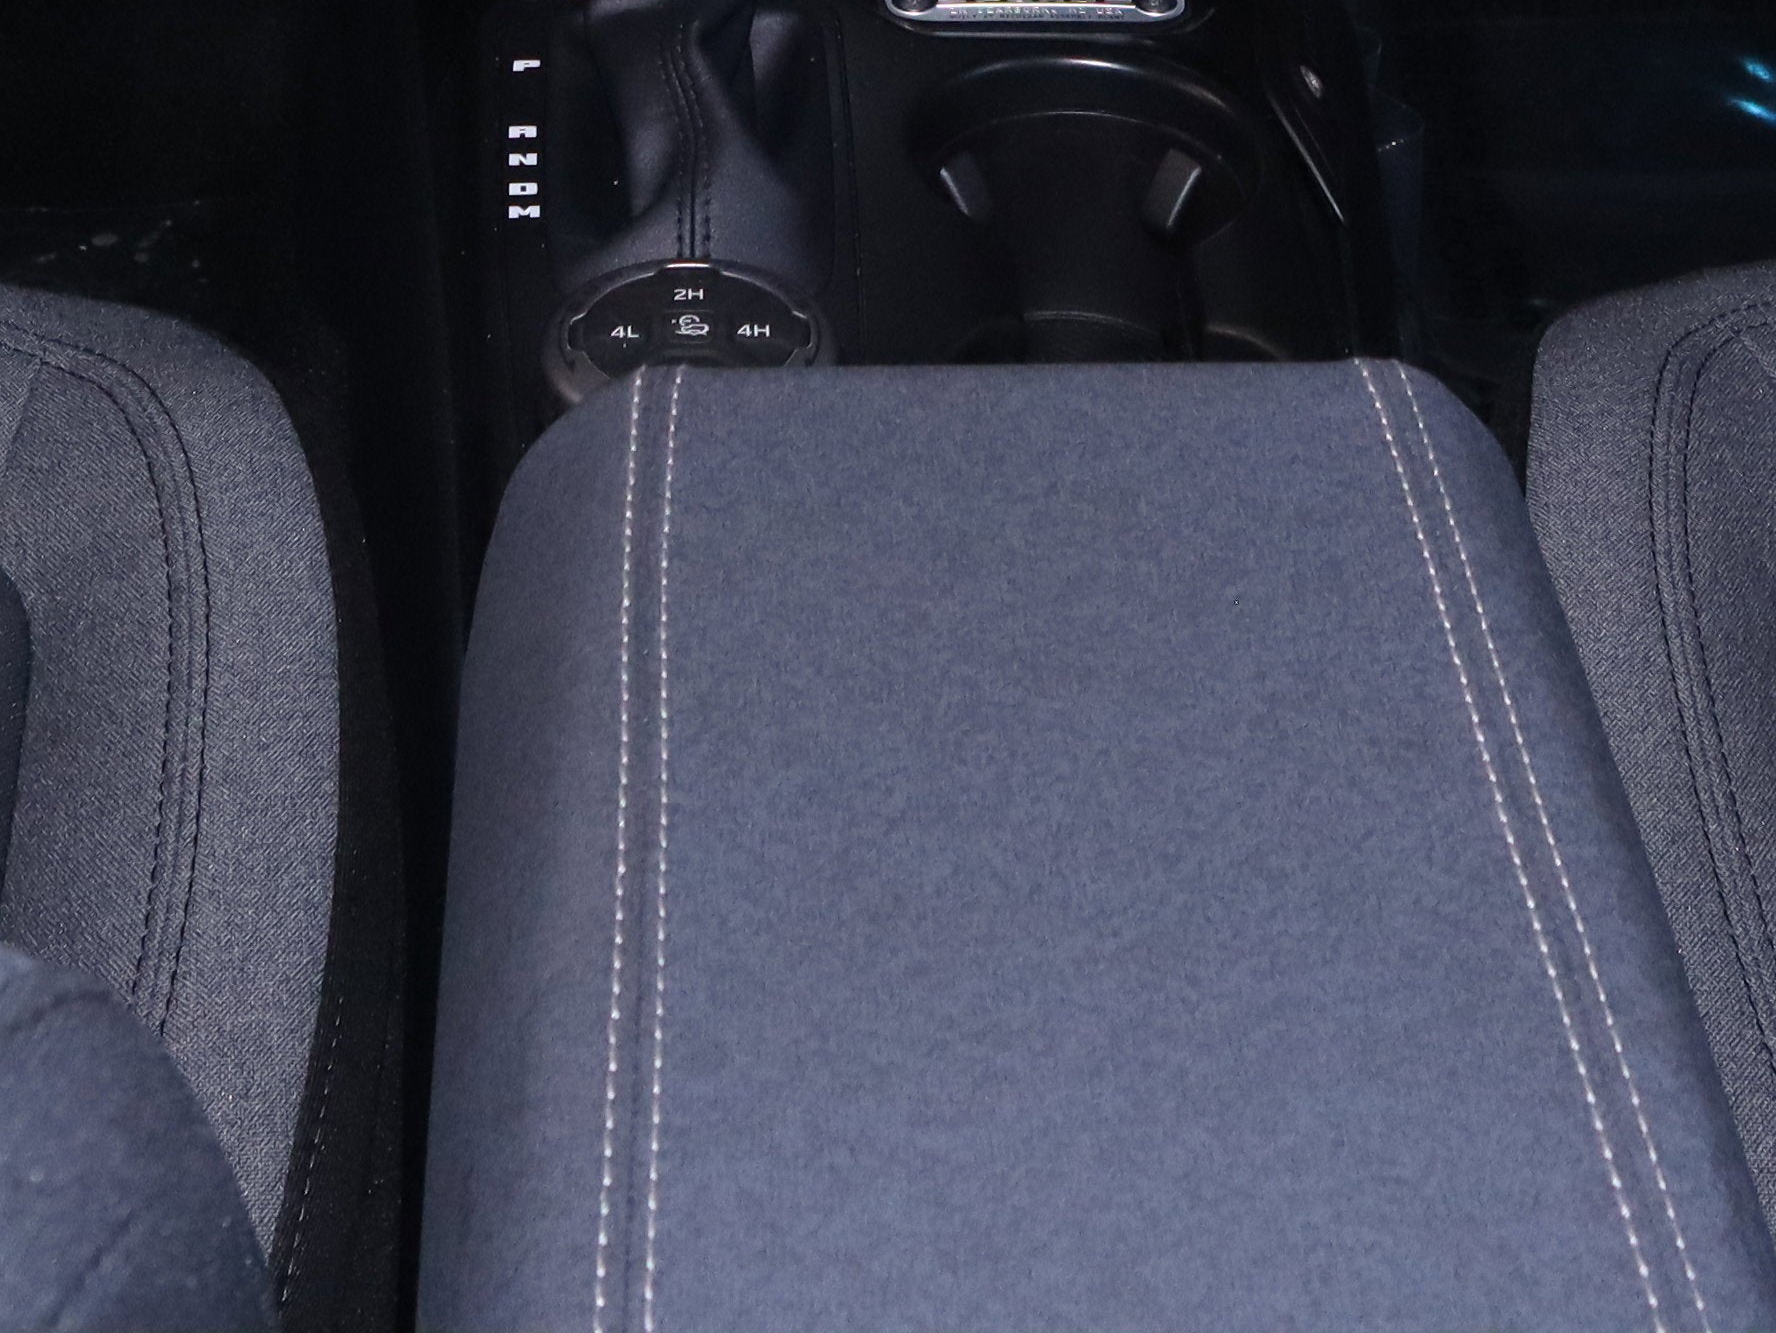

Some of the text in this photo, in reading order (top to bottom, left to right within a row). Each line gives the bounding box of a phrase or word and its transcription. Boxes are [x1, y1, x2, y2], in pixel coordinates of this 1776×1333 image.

[508, 153, 538, 165] N
[508, 182, 538, 195] D
[508, 205, 540, 218] M
[673, 288, 704, 301] 2H
[610, 325, 640, 338] 4L
[736, 323, 770, 337] 4H
